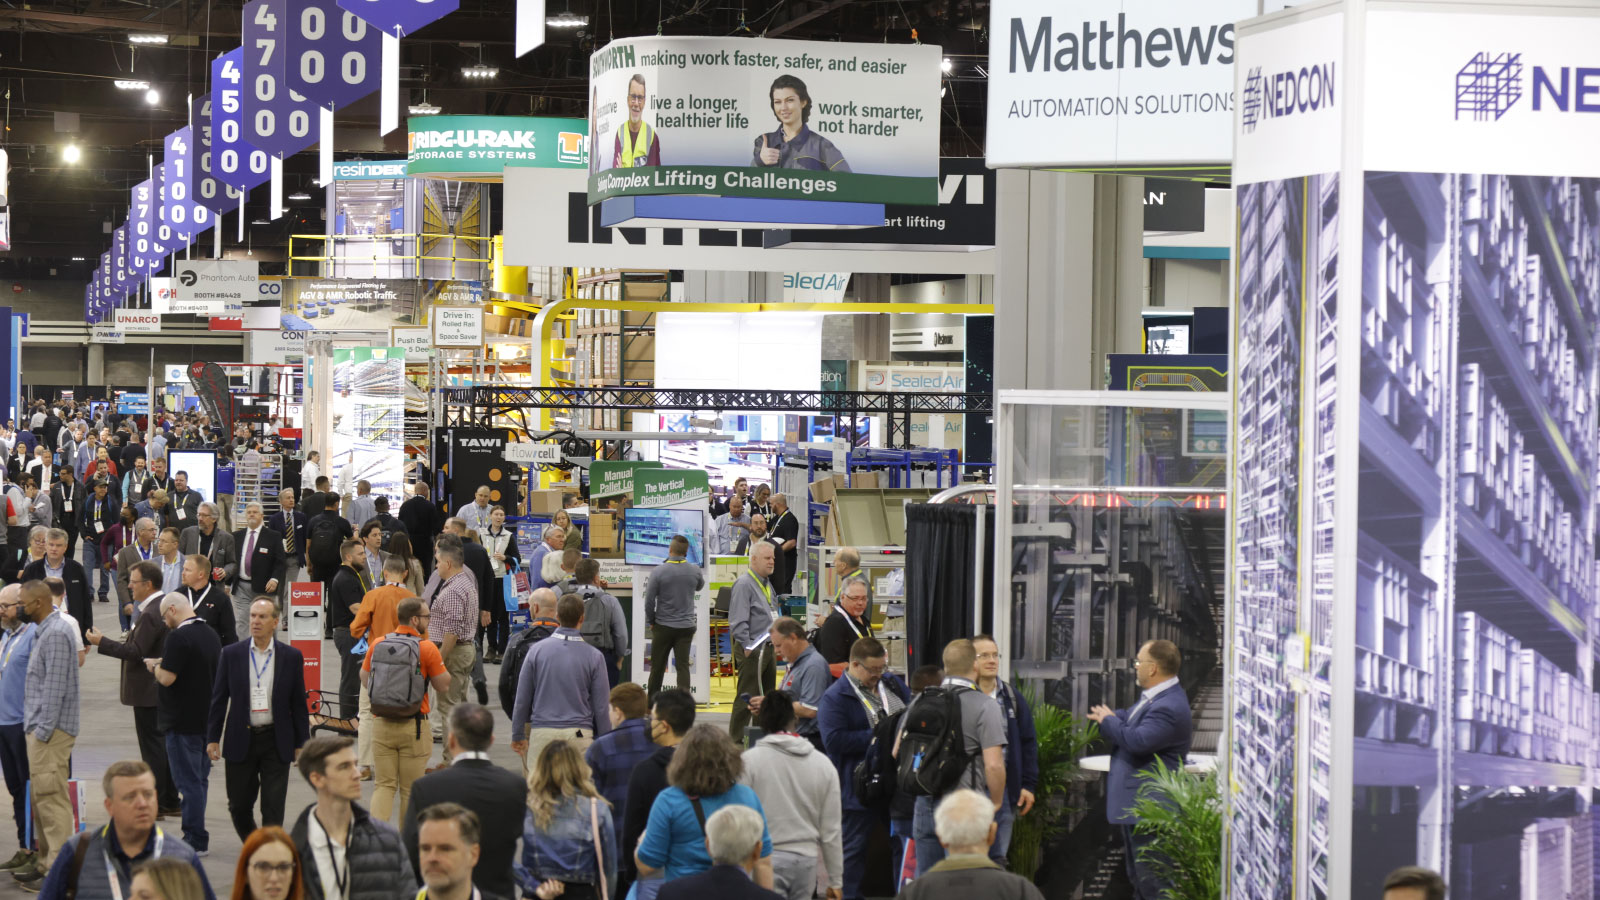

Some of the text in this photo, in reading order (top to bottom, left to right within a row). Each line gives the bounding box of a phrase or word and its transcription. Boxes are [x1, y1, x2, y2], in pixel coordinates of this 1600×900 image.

[1009, 12, 1235, 74] Matthews
[254, 4, 277, 137] 4700
[640, 50, 687, 69] making
[691, 50, 730, 66] work
[733, 52, 780, 69] faster,
[783, 53, 824, 71] safer,
[827, 55, 857, 72] and
[861, 57, 907, 75] easier
[1263, 61, 1335, 120] NEDCON
[650, 94, 738, 113] live a longer,
[1008, 95, 1128, 119] AUTOMATION
[221, 60, 241, 174] 4500
[655, 112, 749, 128] healthier life
[818, 103, 924, 122] work smarter,
[818, 119, 899, 137] not harder
[415, 150, 536, 160] STORAGE SYSTEMS
[333, 162, 405, 177] resinDEK
[171, 137, 187, 223] 4100
[607, 171, 650, 192] Complex
[653, 170, 717, 190] Lifting
[723, 171, 838, 194] Challenges
[137, 187, 149, 253] 3700
[906, 215, 946, 231] lifting
[200, 274, 256, 282] Phantom Auto
[825, 273, 846, 291] Air
[300, 291, 398, 300] AGV & AMR Robotic Traffic
[438, 292, 452, 300] AGV
[117, 315, 159, 324] UNARCO
[442, 311, 475, 319] Drive In:
[441, 320, 476, 328] Rolled Rail
[439, 333, 477, 342] Space Saver
[891, 374, 942, 388] Sealed
[943, 374, 964, 388] Air
[944, 421, 961, 433] Air
[459, 438, 501, 447] TAWI
[604, 467, 633, 482] Manual
[600, 480, 622, 494] Pallet
[644, 478, 685, 494] The Vertical
[641, 486, 704, 505] Distribution Center
